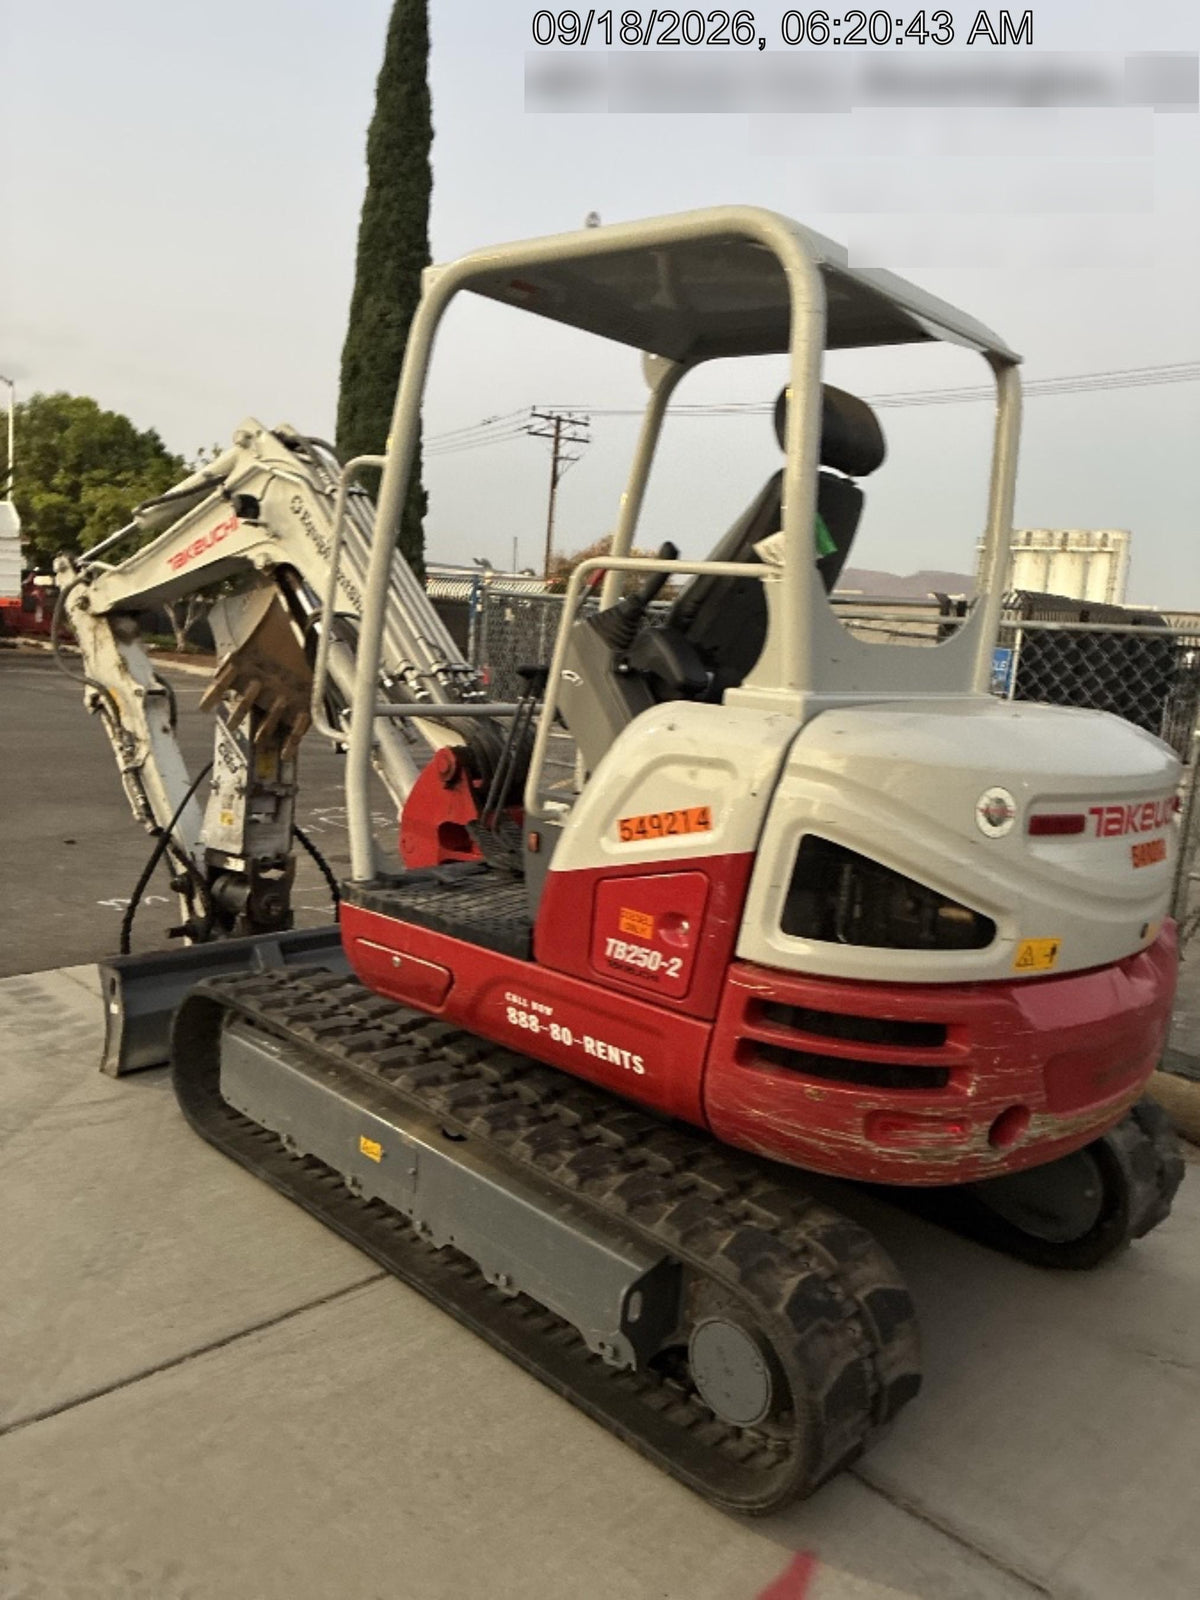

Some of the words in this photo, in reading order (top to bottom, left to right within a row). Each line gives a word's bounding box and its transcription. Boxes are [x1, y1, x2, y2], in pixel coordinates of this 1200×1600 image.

[166, 517, 239, 572] TAKEUCHI
[620, 807, 709, 842] 549214
[605, 937, 683, 978] TB250-2
[506, 1006, 645, 1075] 888-80-RENTS
